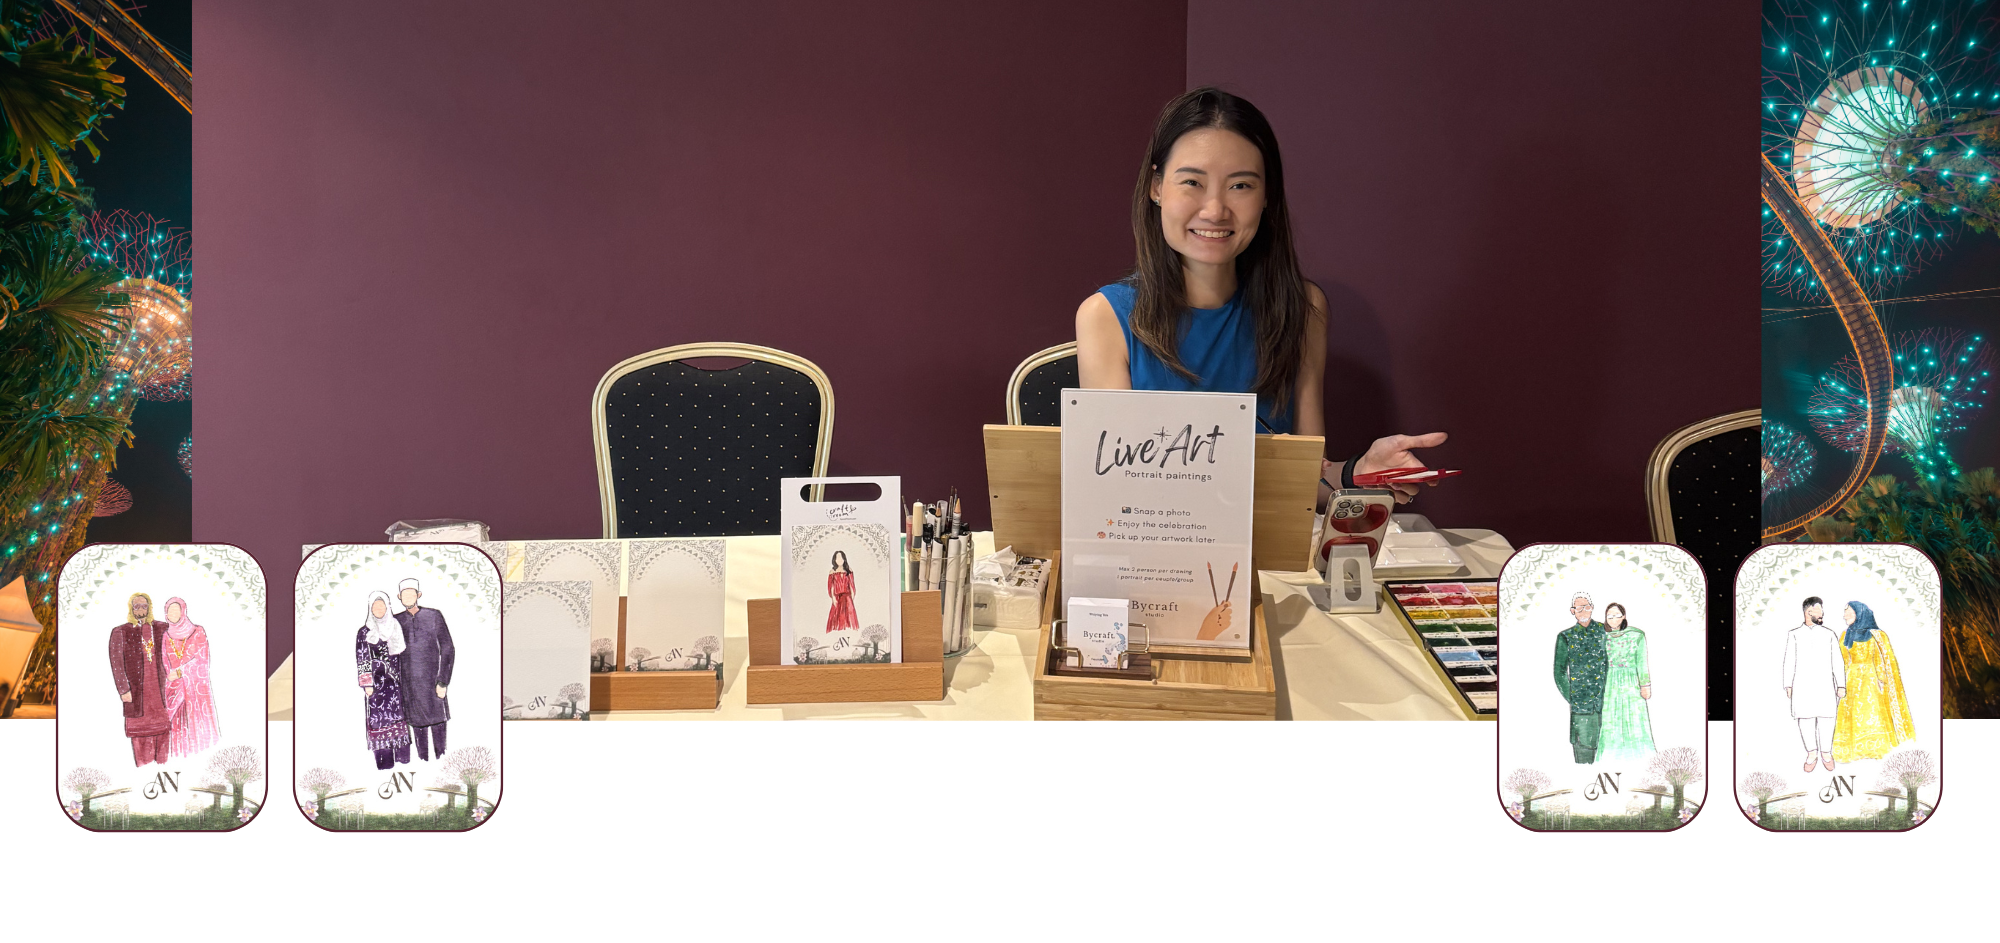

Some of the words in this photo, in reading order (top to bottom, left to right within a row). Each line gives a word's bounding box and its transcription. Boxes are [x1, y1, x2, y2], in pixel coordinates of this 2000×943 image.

[1095, 430, 1160, 476] Live
[1159, 424, 1225, 469] Art
[1125, 470, 1163, 479] Portrait
[1166, 472, 1212, 483] paintings
[1133, 507, 1156, 516] Snap
[1166, 509, 1191, 517] photo
[1117, 519, 1140, 529] Enjoy
[1142, 520, 1156, 528] the
[1158, 521, 1207, 530] celebration
[1108, 532, 1126, 540] Pick
[1161, 535, 1194, 543] artwork
[1195, 536, 1216, 544] later
[1131, 600, 1179, 613] Bycraft
